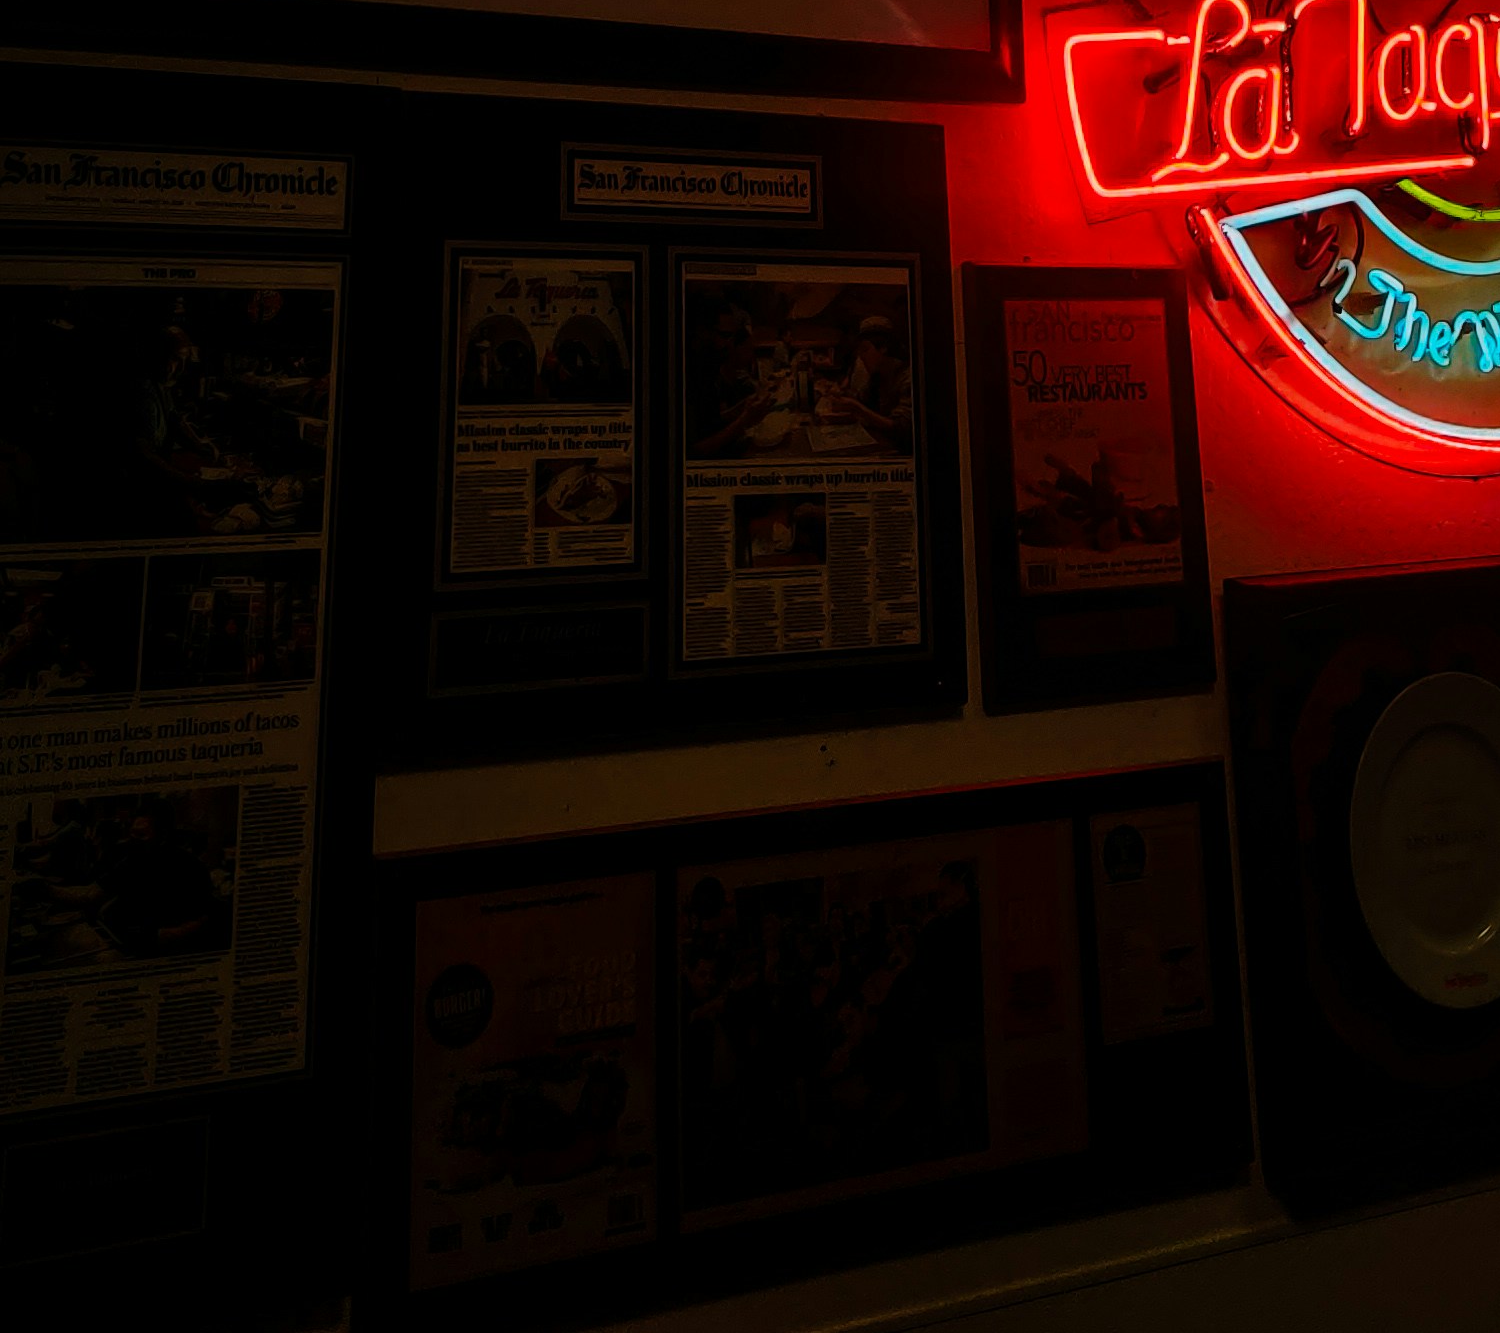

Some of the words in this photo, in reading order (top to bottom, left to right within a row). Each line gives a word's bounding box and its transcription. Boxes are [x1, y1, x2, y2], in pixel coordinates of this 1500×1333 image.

[2, 151, 61, 185] San
[64, 152, 205, 191] Francisco
[211, 161, 339, 196] Chronicle
[579, 164, 618, 191] San
[621, 166, 716, 197] Francisco
[720, 170, 809, 200] Chronicle
[1013, 350, 1048, 386] 50
[1050, 366, 1091, 383] VERY
[1095, 365, 1132, 383] BEST
[1028, 382, 1149, 403] RESTAURANTS
[686, 474, 738, 488] Mission
[740, 472, 783, 486] classic
[785, 474, 824, 488] wraps
[826, 474, 842, 487] up
[844, 469, 888, 484] burrito
[8, 733, 42, 750] one
[48, 729, 89, 747] man
[94, 721, 152, 744] makes
[157, 716, 231, 739] millions
[233, 711, 255, 733] of
[255, 712, 301, 730] tacos
[68, 748, 115, 771] most
[117, 745, 187, 766] famous
[192, 737, 264, 762] taqueria
